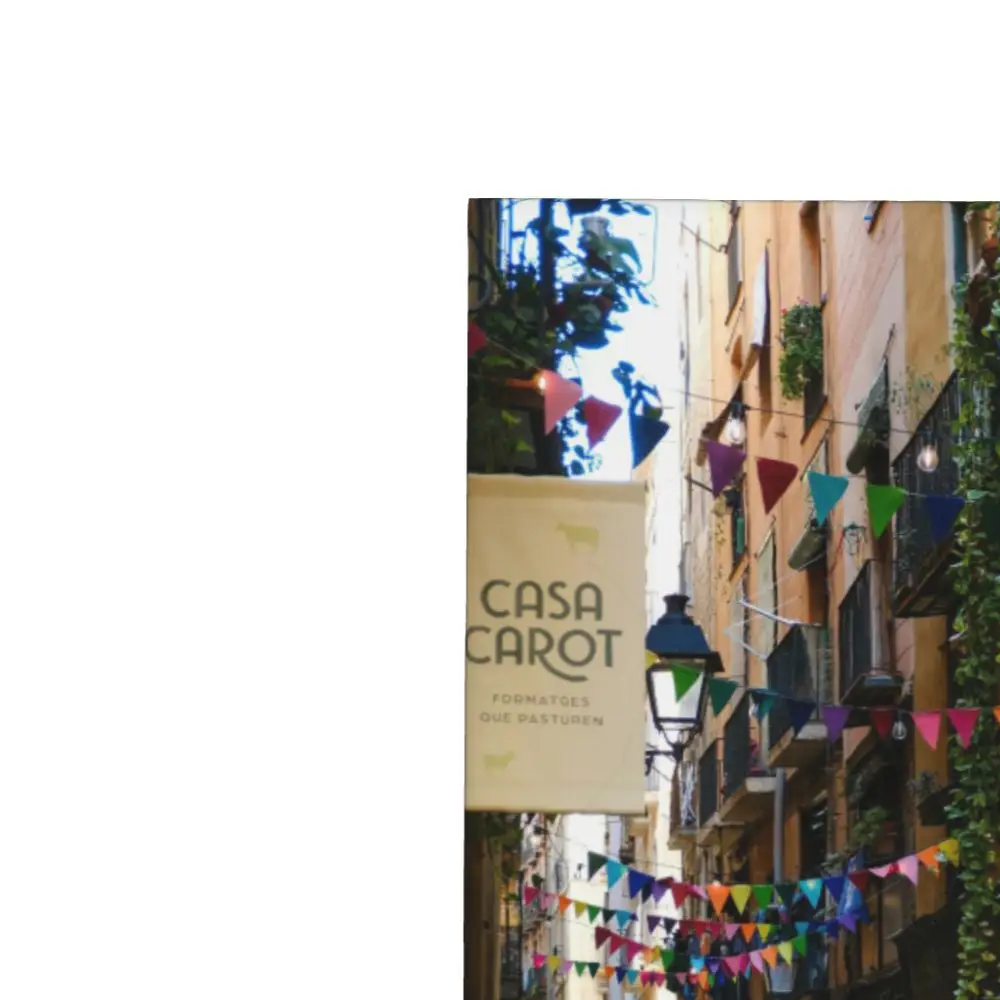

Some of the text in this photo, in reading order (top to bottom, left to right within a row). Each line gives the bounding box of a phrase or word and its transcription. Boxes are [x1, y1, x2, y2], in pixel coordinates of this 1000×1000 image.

[480, 579, 603, 621] CASA
[465, 625, 622, 682] CAROT
[492, 694, 590, 708] FORMATGES
[479, 712, 604, 727] QUE PASTUREN
